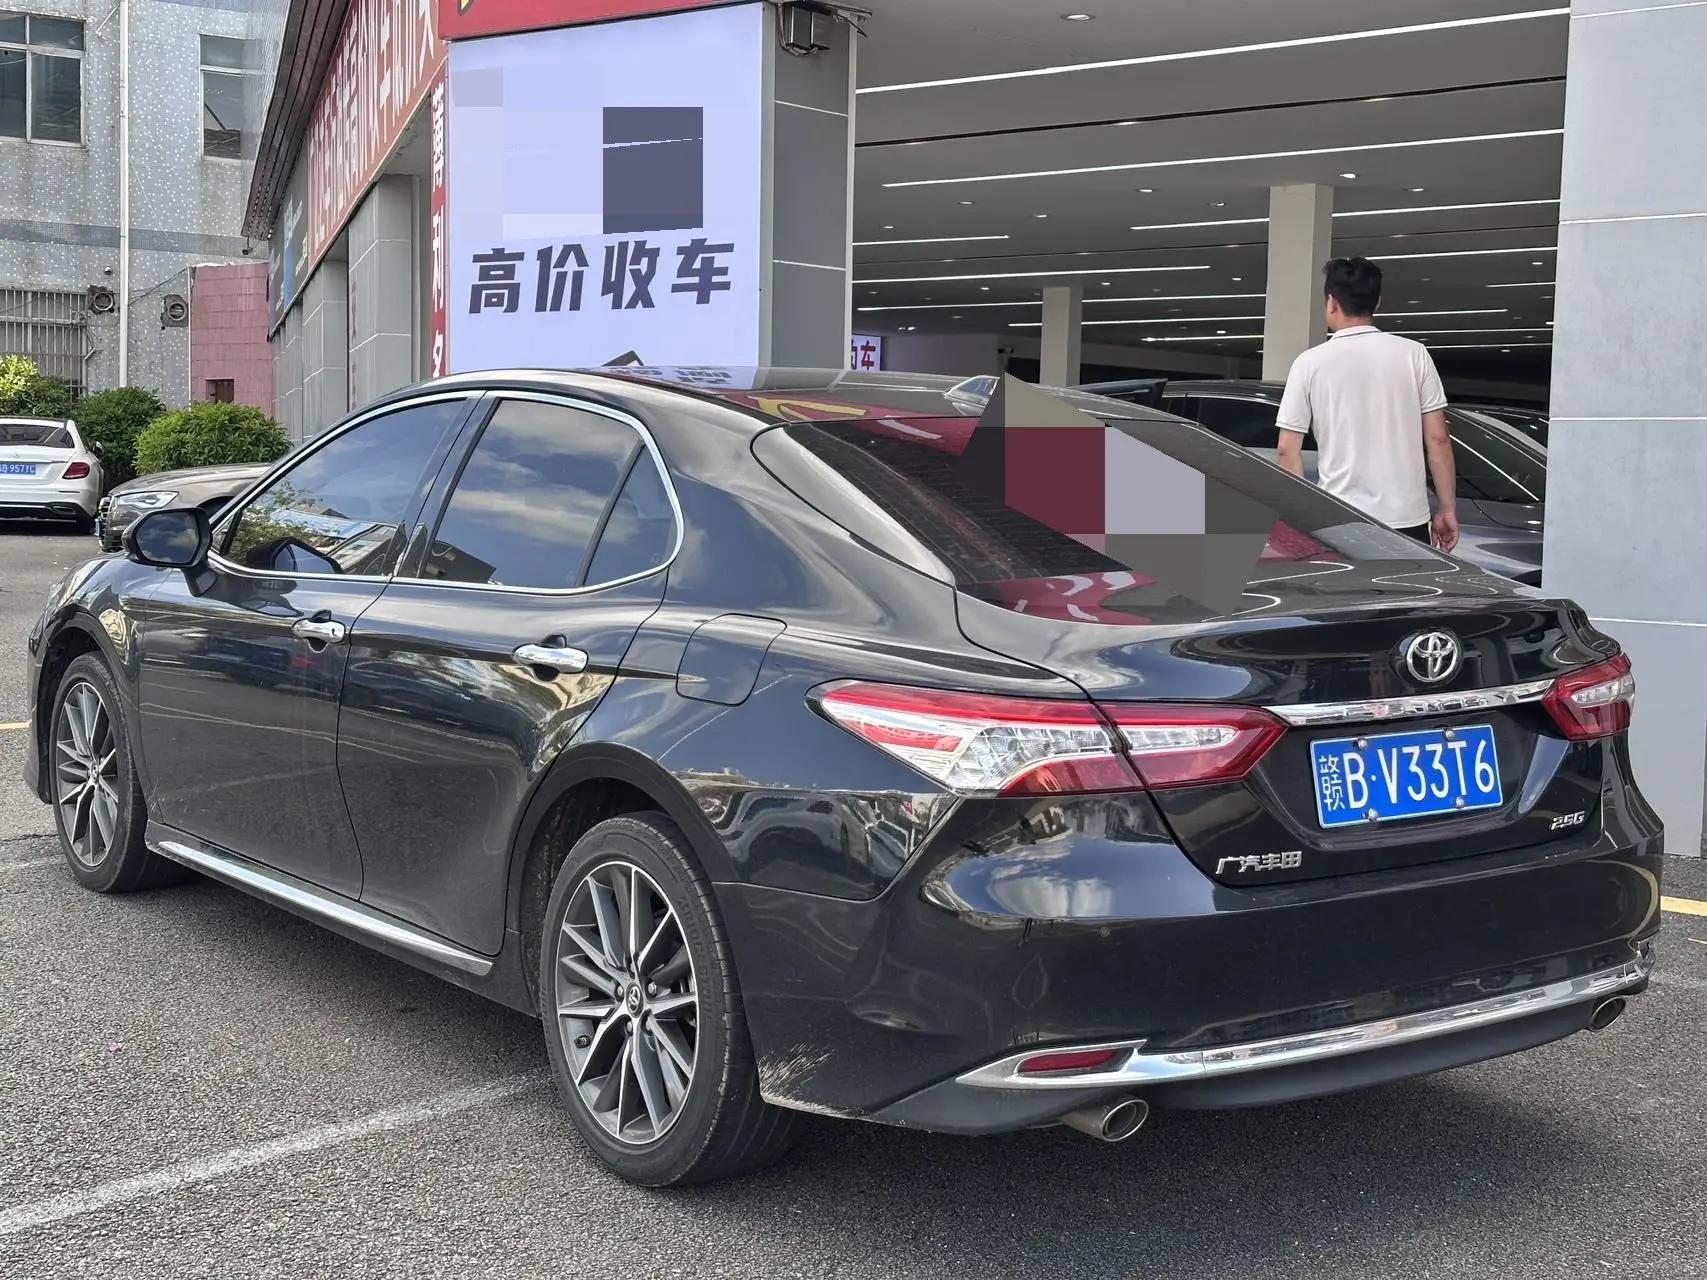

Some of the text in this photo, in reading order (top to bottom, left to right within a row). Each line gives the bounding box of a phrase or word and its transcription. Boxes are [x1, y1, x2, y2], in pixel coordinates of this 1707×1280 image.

[469, 238, 734, 314] 高价收车
[1215, 851, 1302, 874] 广汽丰田
